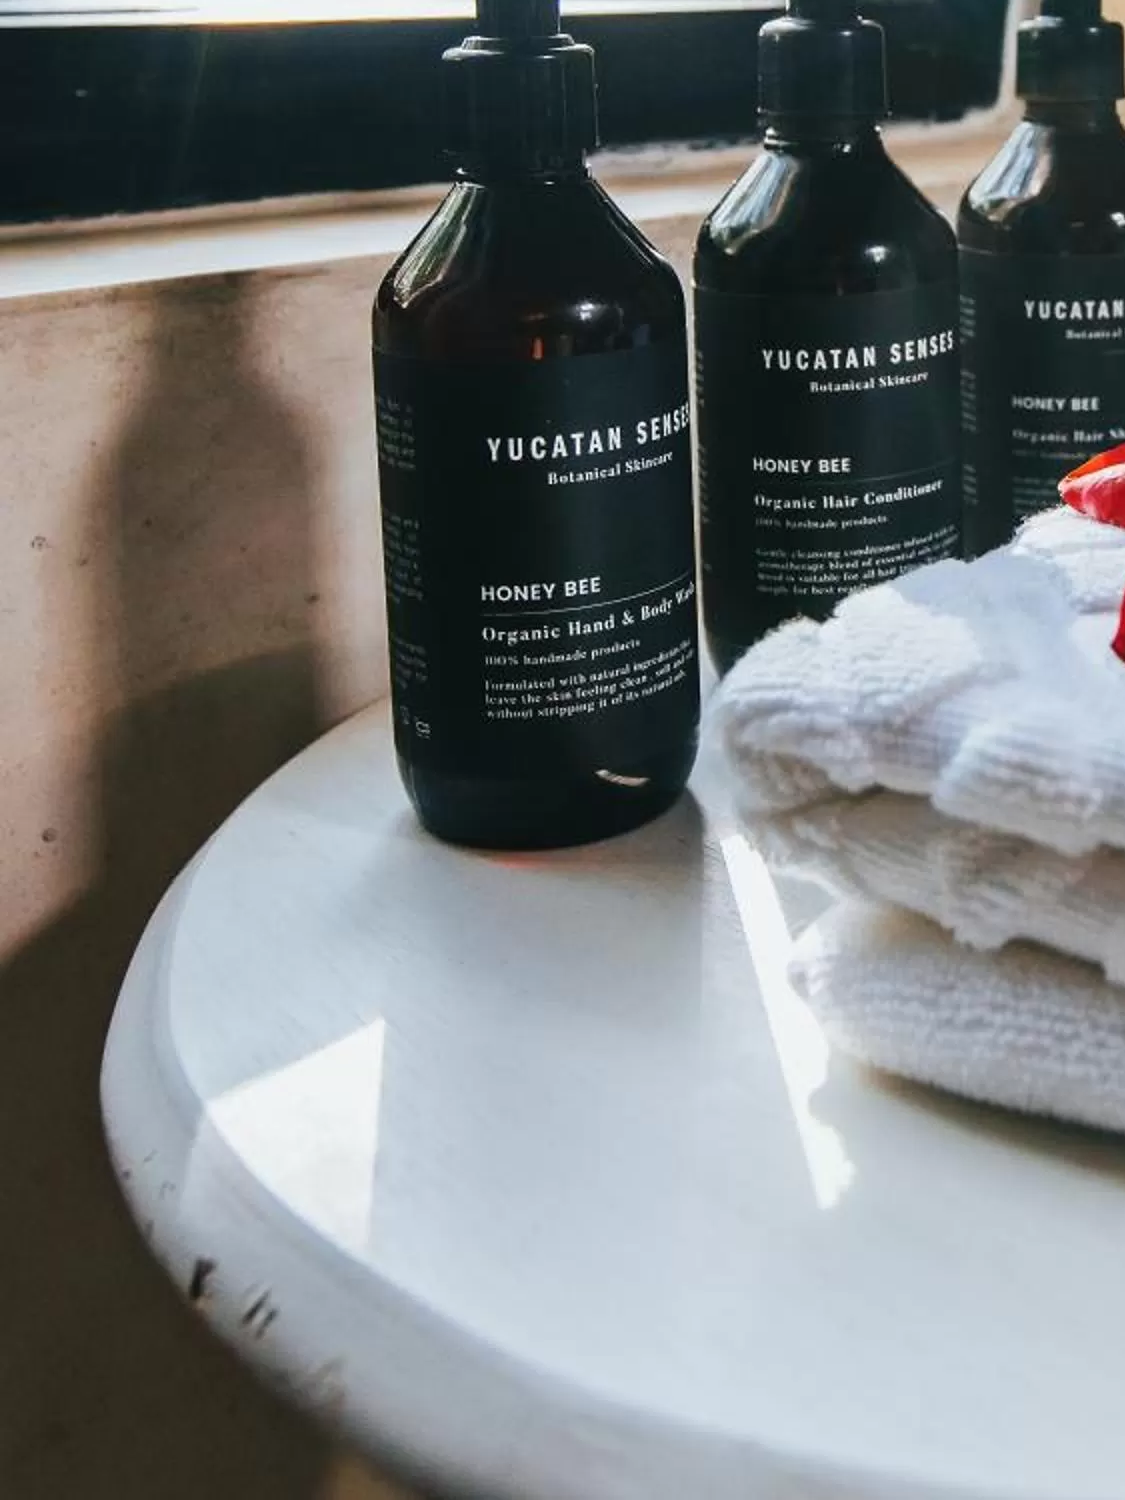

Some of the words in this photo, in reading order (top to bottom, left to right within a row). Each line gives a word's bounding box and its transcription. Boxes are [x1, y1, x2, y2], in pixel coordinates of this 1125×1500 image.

[1023, 300, 1125, 320] YUCATAN
[761, 346, 877, 371] YUCATAN
[889, 330, 954, 365] SENSES
[809, 377, 876, 393] Botanical
[879, 371, 929, 388] Skincare
[1011, 396, 1067, 412] HONEY
[1071, 396, 1100, 412] BEE
[486, 425, 622, 462] YUCATAN
[547, 463, 622, 486] Botanical
[625, 451, 674, 474] Skincare
[752, 457, 814, 474] HONEY
[818, 457, 851, 474] BEE
[754, 494, 817, 511] Organic
[823, 495, 859, 509] Hair
[863, 479, 944, 506] Conditioner
[480, 583, 557, 602] HONEY
[564, 576, 601, 597] BEE
[481, 625, 562, 646] Organic
[568, 613, 616, 637] Hand
[621, 609, 635, 626] &
[641, 597, 673, 621] Body
[523, 648, 587, 666] handmade
[591, 639, 641, 660] products
